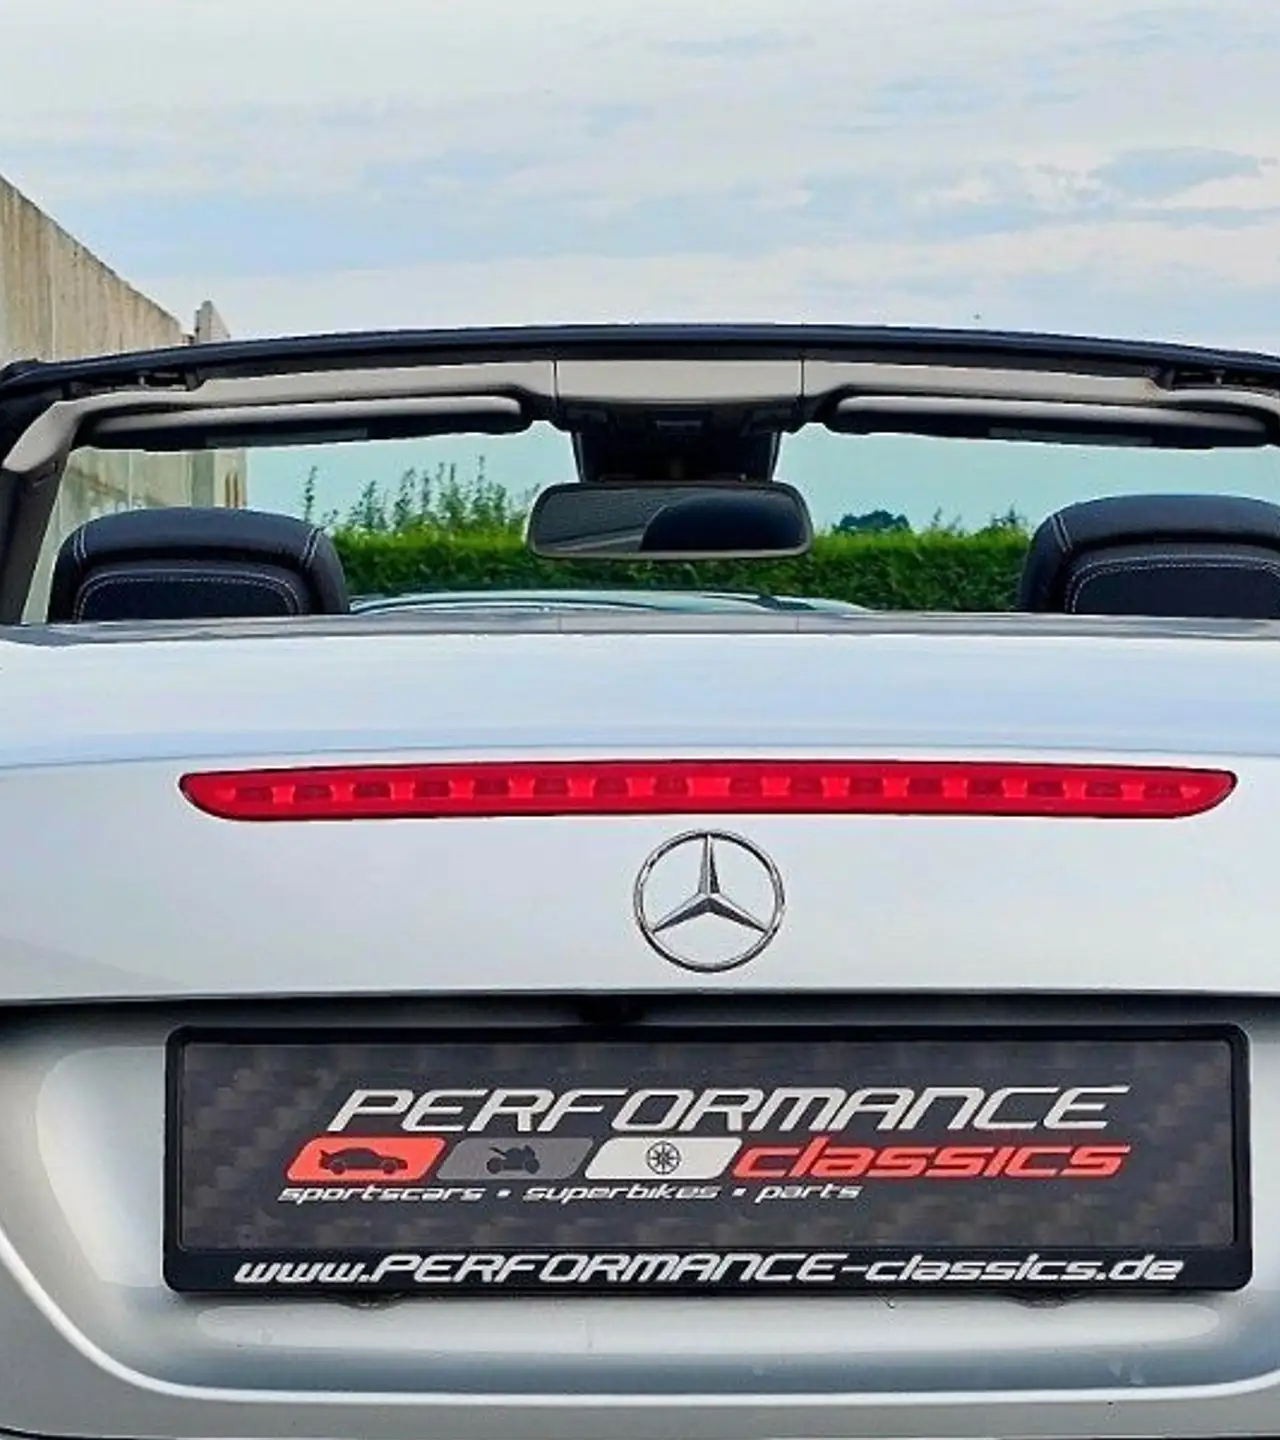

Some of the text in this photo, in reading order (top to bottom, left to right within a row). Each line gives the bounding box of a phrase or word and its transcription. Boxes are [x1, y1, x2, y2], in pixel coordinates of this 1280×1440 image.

[326, 1085, 1131, 1133] PERFORMANCE
[732, 1136, 1133, 1179] classics
[277, 1184, 864, 1205] sportscars superbikes parts
[233, 1252, 1186, 1285] www.PERFORMANCE-classics.de
